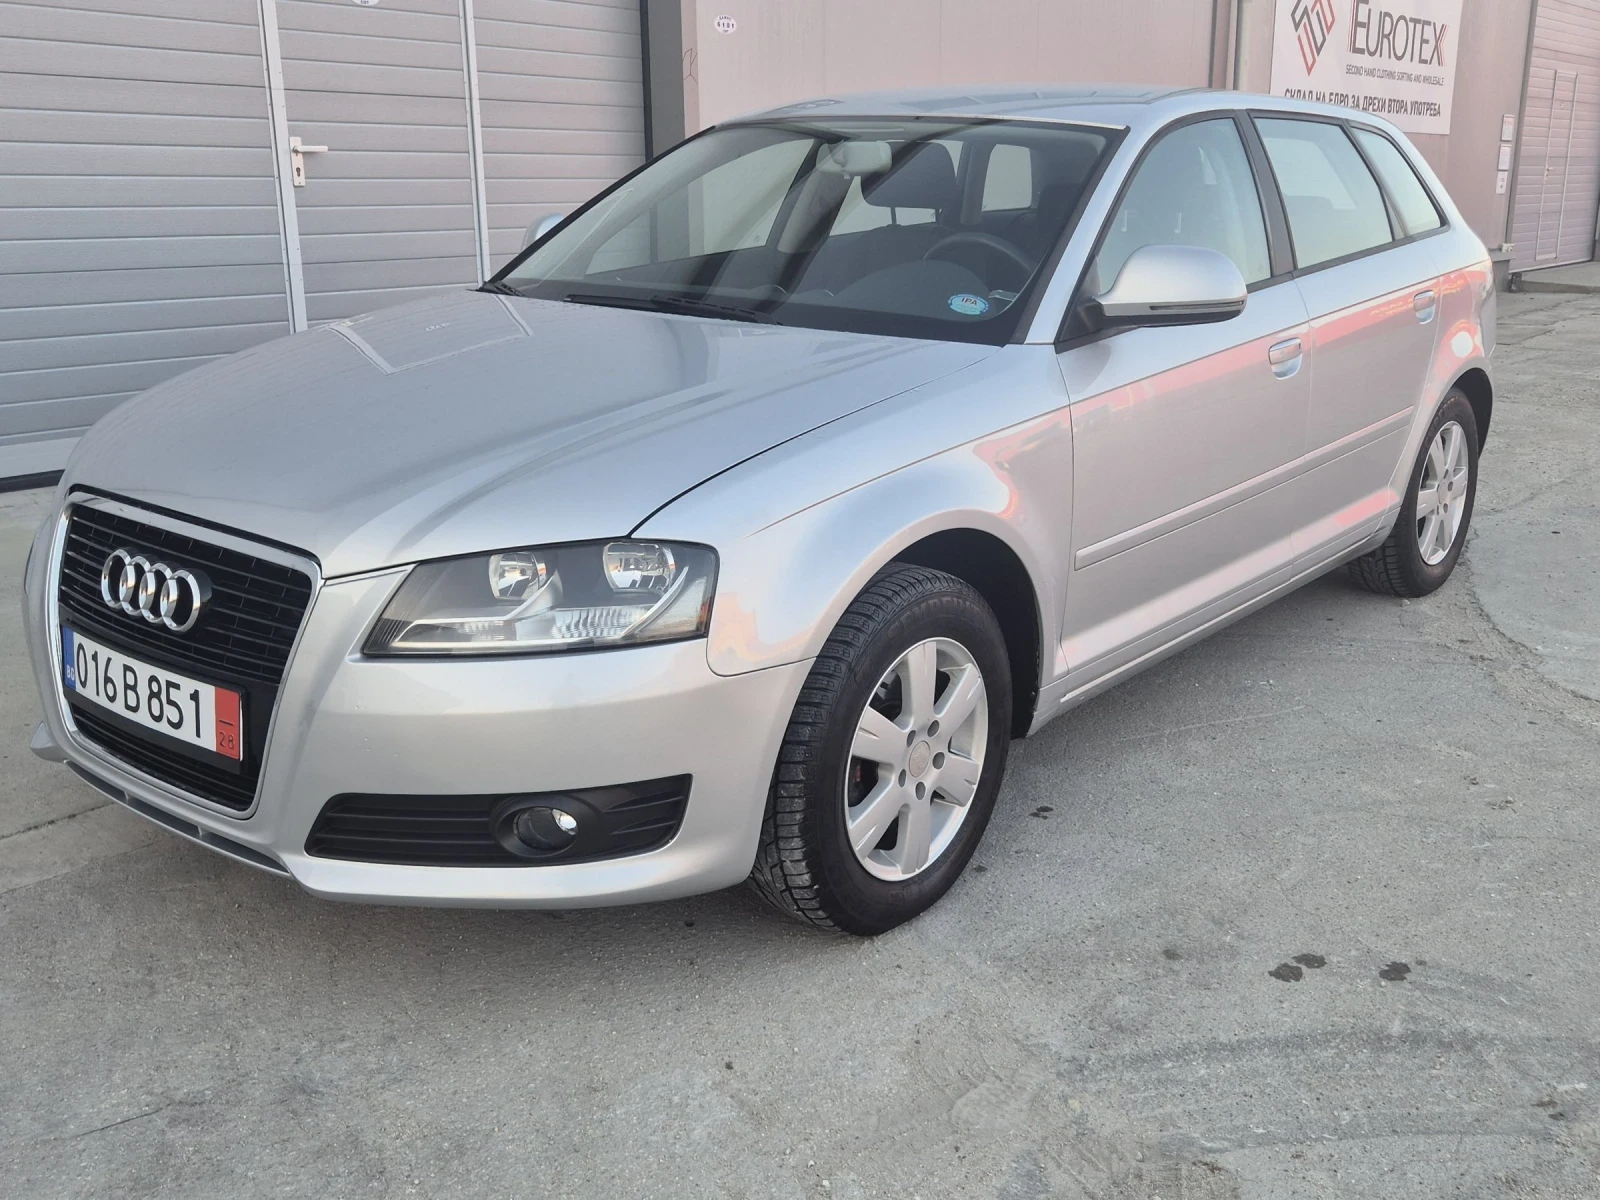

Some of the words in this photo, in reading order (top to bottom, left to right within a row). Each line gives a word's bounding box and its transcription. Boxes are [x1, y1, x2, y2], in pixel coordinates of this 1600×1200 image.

[1350, 0, 1448, 66] EUROTEX
[1345, 64, 1364, 76] SECOND
[1363, 67, 1376, 78] HAND
[1376, 68, 1396, 80] CLOTHING
[1396, 71, 1413, 82] SORTING
[1422, 75, 1444, 86] WHOLESALE
[1351, 94, 1360, 110] ЗА
[1361, 96, 1386, 113] ДРЕХИ
[1387, 99, 1408, 115] ВТОРА
[1409, 101, 1441, 117] УПОТРЕБА
[67, 664, 75, 681] BG
[76, 642, 117, 703] 016
[123, 663, 140, 713] B
[147, 674, 201, 739] 851
[219, 731, 235, 750] 28
